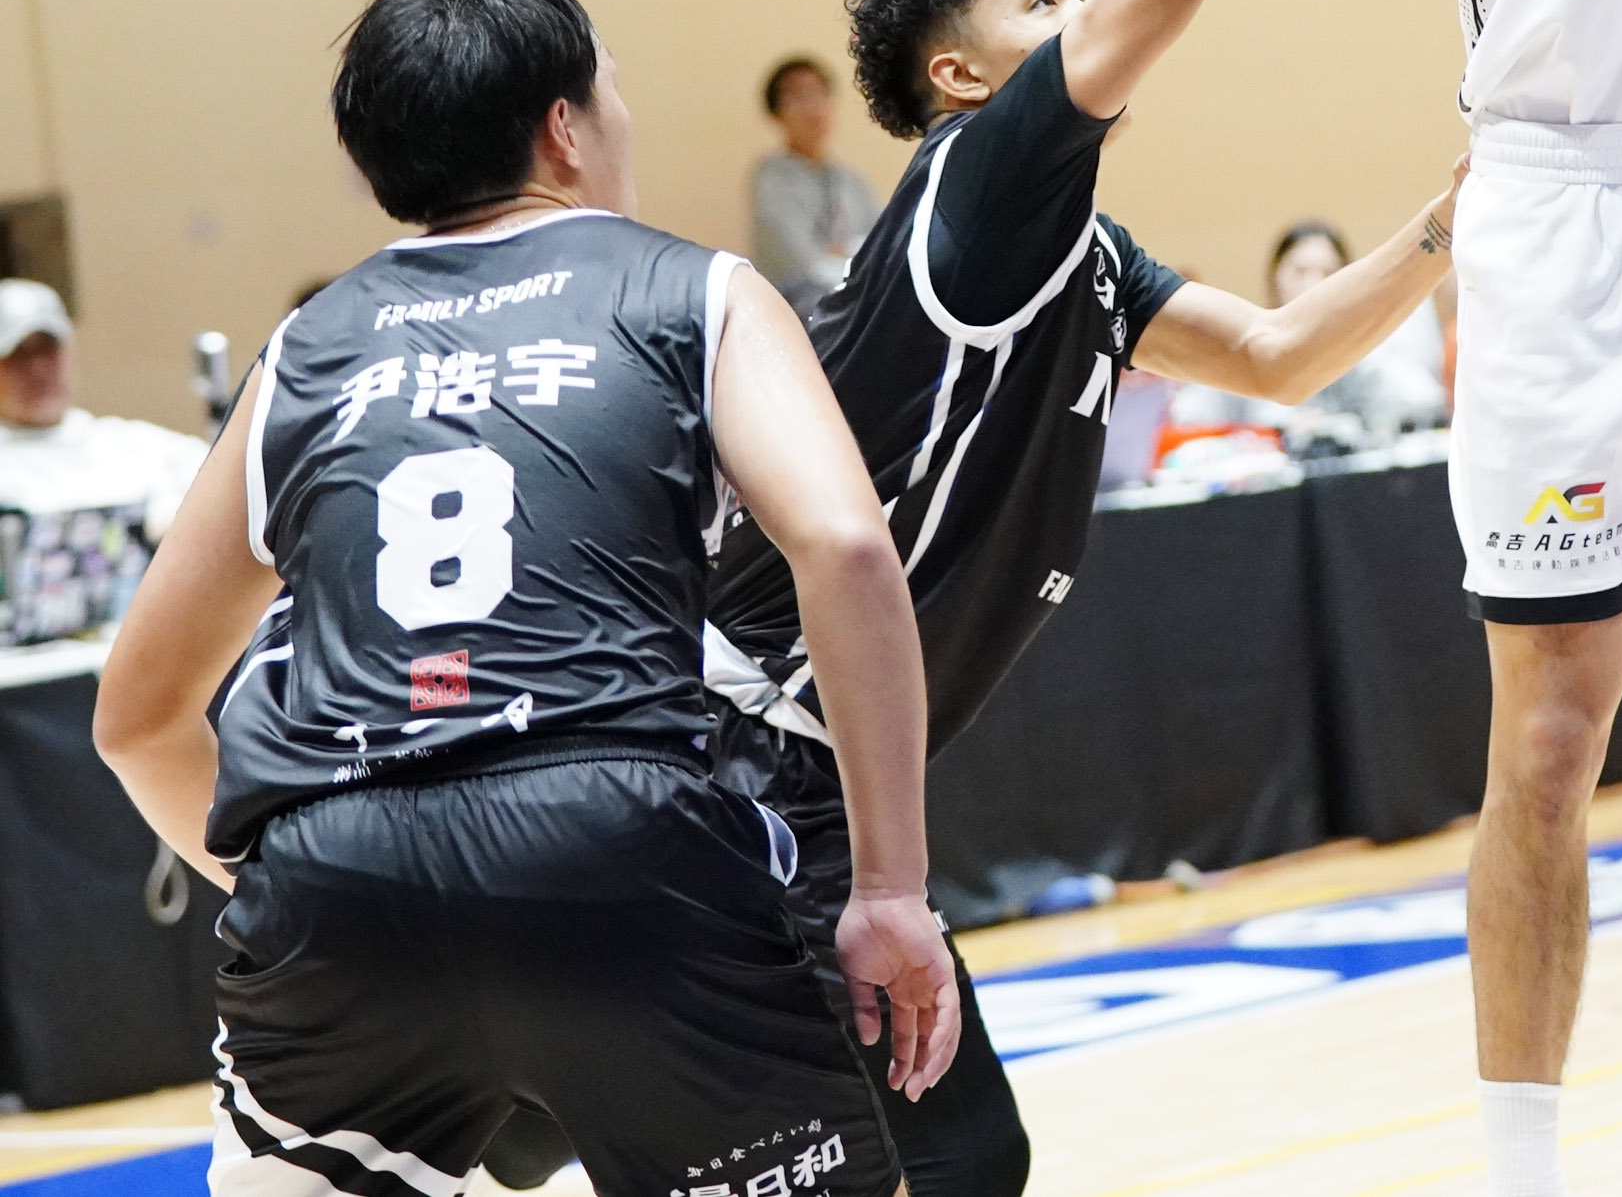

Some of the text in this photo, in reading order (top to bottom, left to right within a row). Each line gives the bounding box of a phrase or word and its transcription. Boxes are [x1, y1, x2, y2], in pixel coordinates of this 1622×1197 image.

[373, 271, 573, 331] FAMILY SPORT
[331, 338, 597, 444] 尹浩宇
[376, 445, 515, 631] 8
